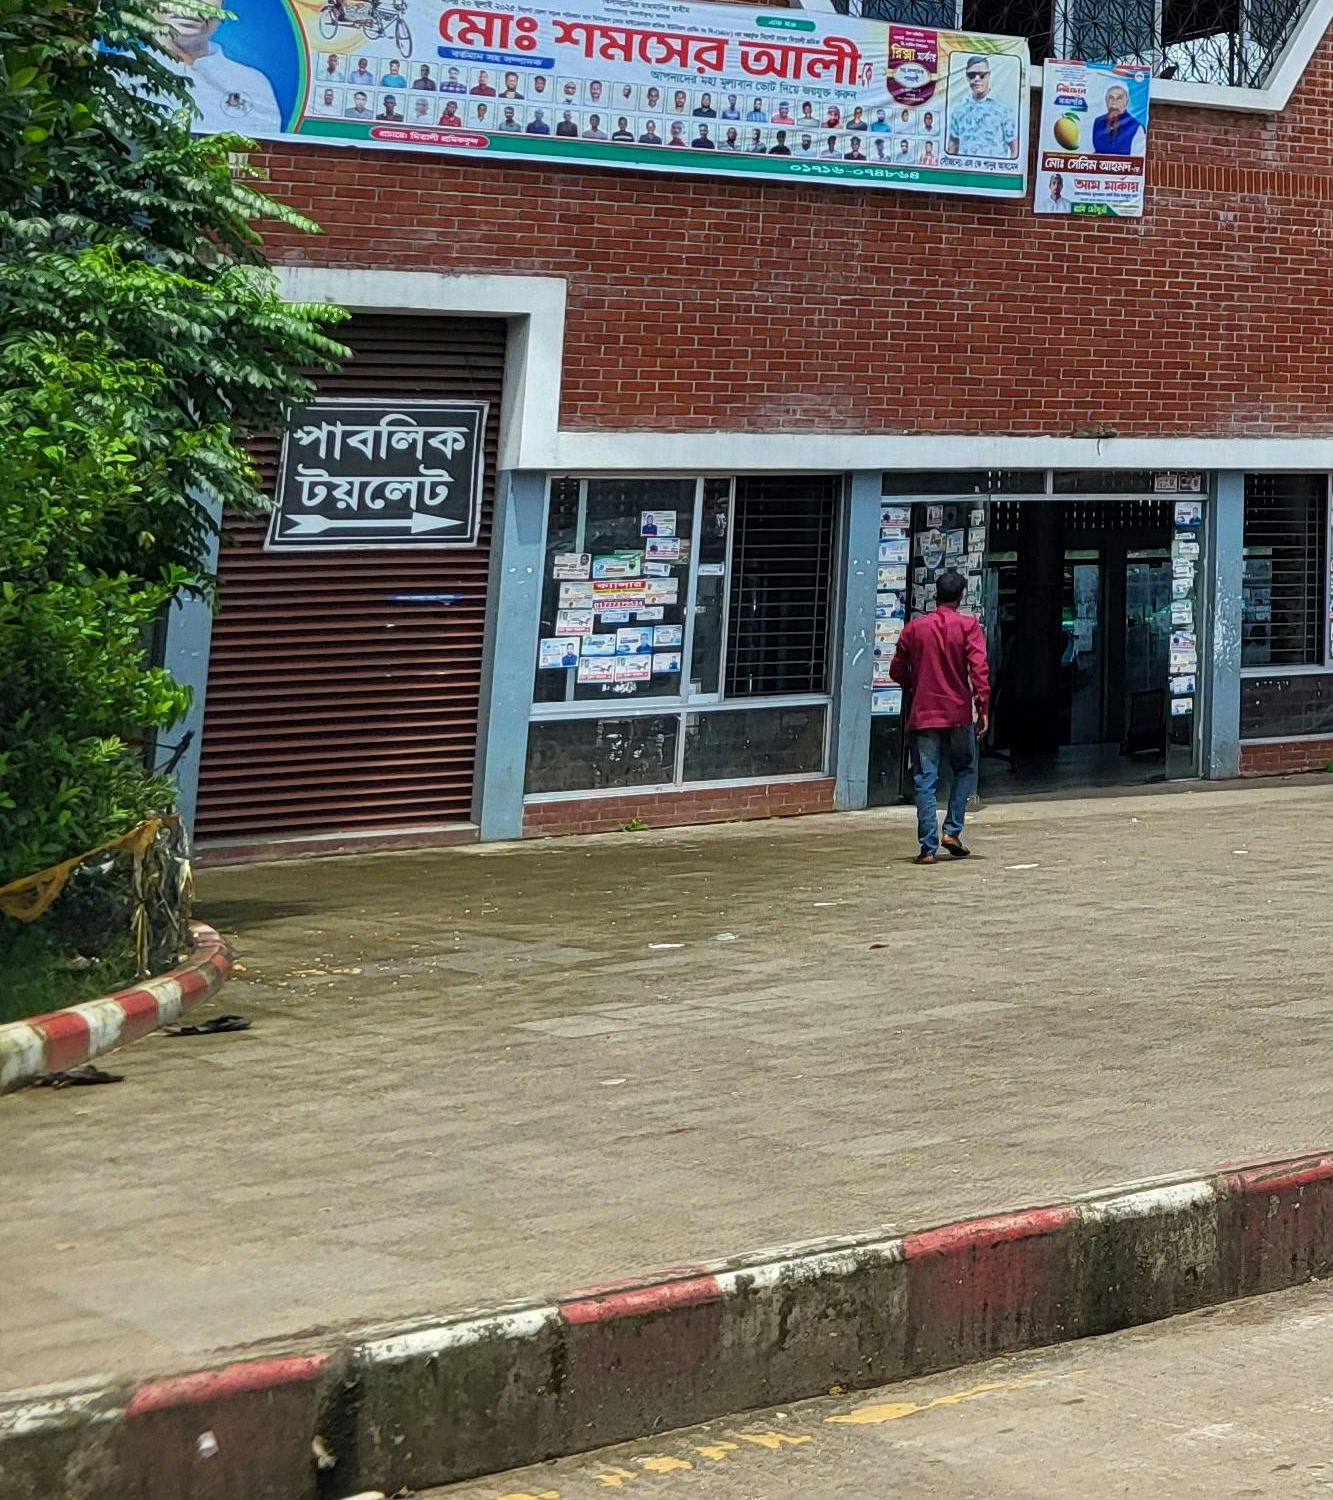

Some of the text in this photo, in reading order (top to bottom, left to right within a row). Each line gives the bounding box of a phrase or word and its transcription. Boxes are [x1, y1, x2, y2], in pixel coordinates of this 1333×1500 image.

[438, 7, 539, 51] মোঃ
[551, 19, 730, 75] শমসের
[651, 69, 697, 86] আপনাদের
[700, 75, 718, 87] মহা
[756, 79, 777, 93] ভোট
[779, 81, 800, 95] দিয়ে
[834, 87, 857, 100] করুন
[1044, 157, 1065, 169] মোঃ
[1067, 156, 1097, 171] সেলিম
[1074, 176, 1140, 192] আম মার্কায়
[293, 413, 471, 461] পাবলিক
[294, 463, 455, 511] টয়লেট
